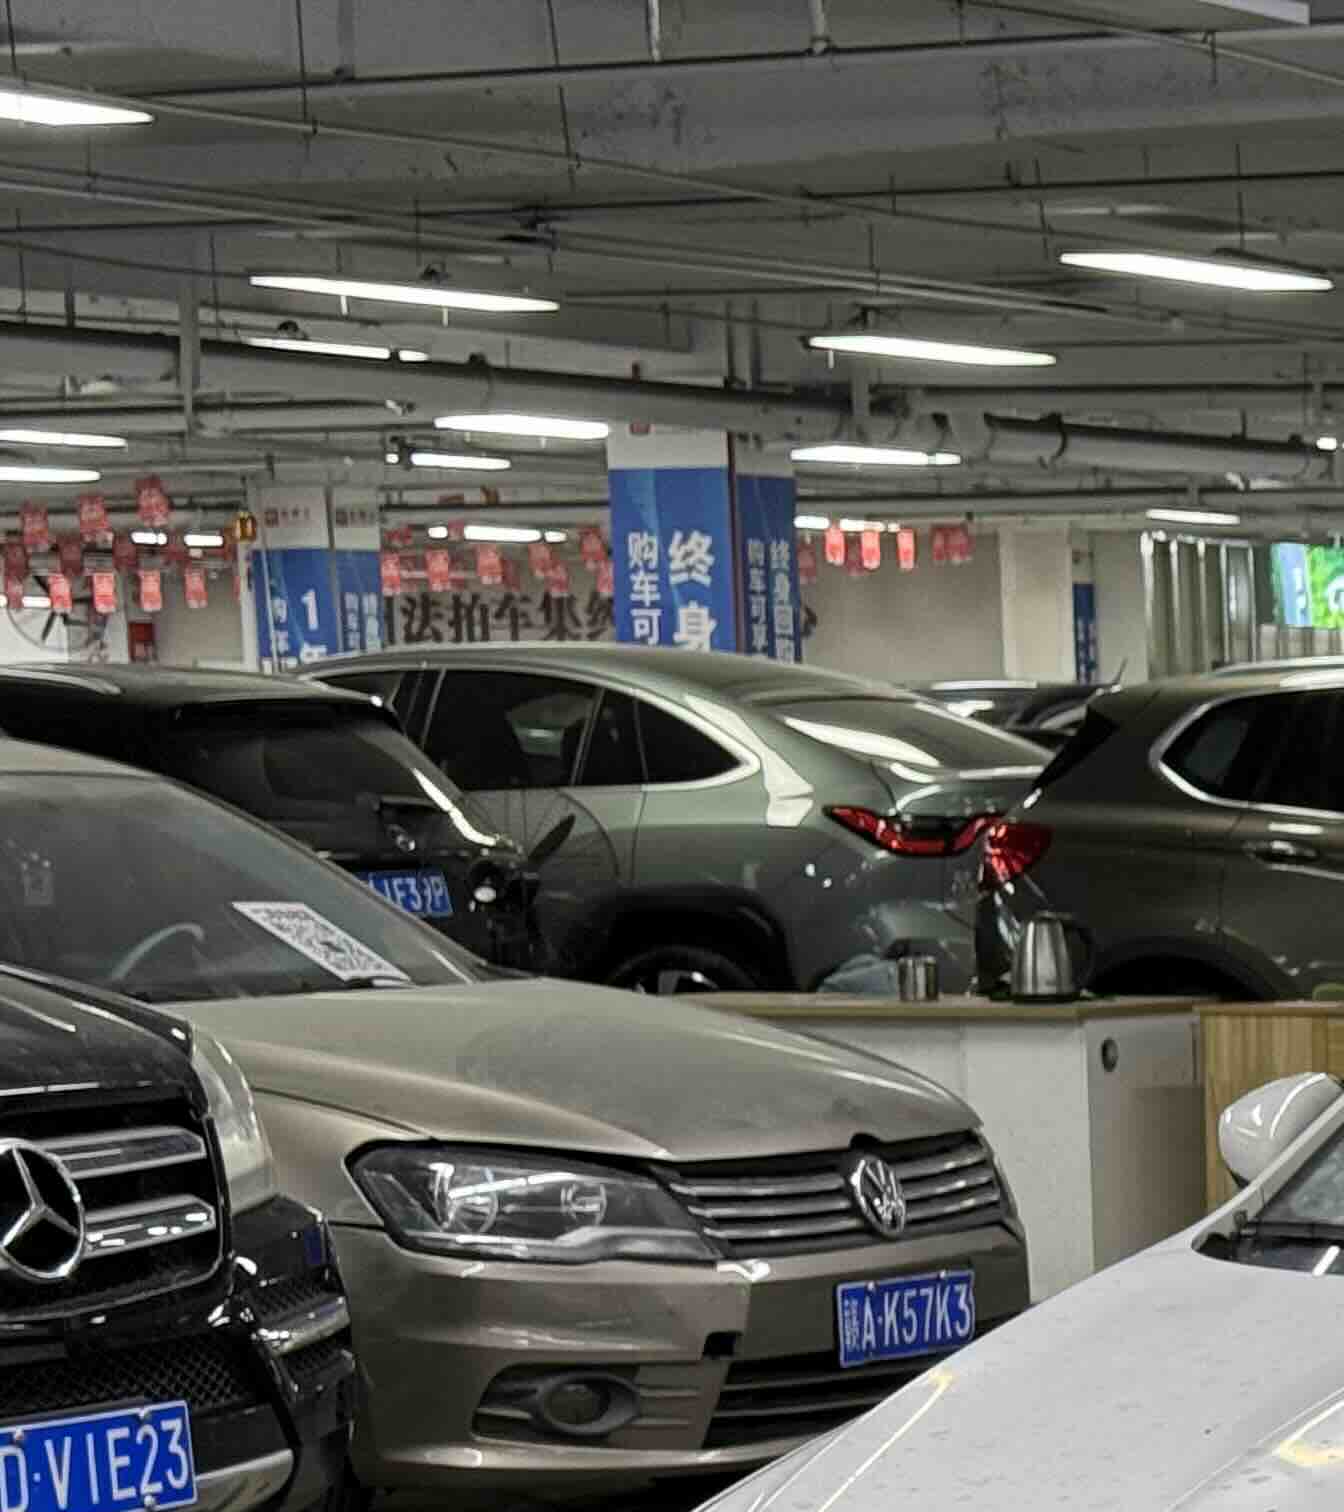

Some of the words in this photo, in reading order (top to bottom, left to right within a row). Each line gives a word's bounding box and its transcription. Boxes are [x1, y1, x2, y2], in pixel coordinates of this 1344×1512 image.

[383, 592, 614, 643] 法拍车集
[627, 531, 662, 645] 购车可
